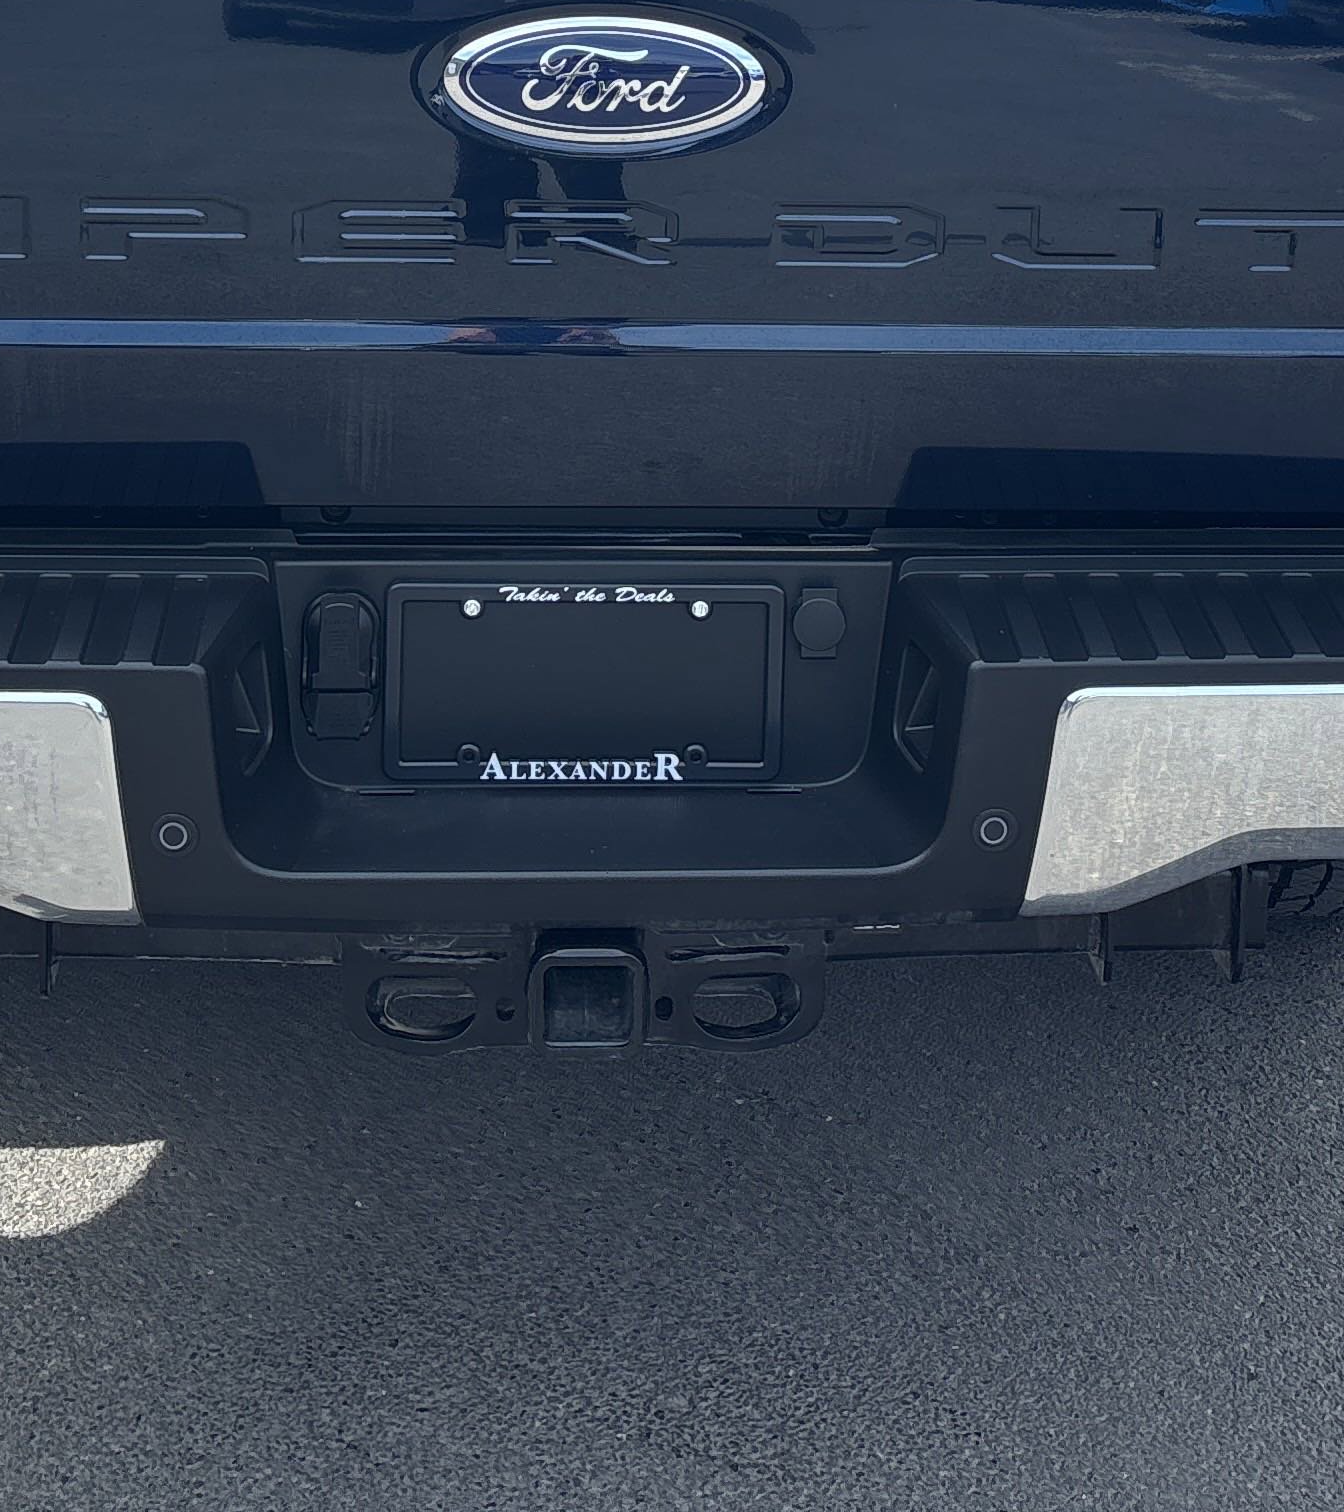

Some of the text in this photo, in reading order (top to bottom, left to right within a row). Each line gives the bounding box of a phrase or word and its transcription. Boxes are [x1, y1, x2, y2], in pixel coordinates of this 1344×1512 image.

[521, 44, 691, 112] Ford
[498, 586, 676, 603] Takin' the Deals
[479, 752, 684, 781] ALEXANDER
